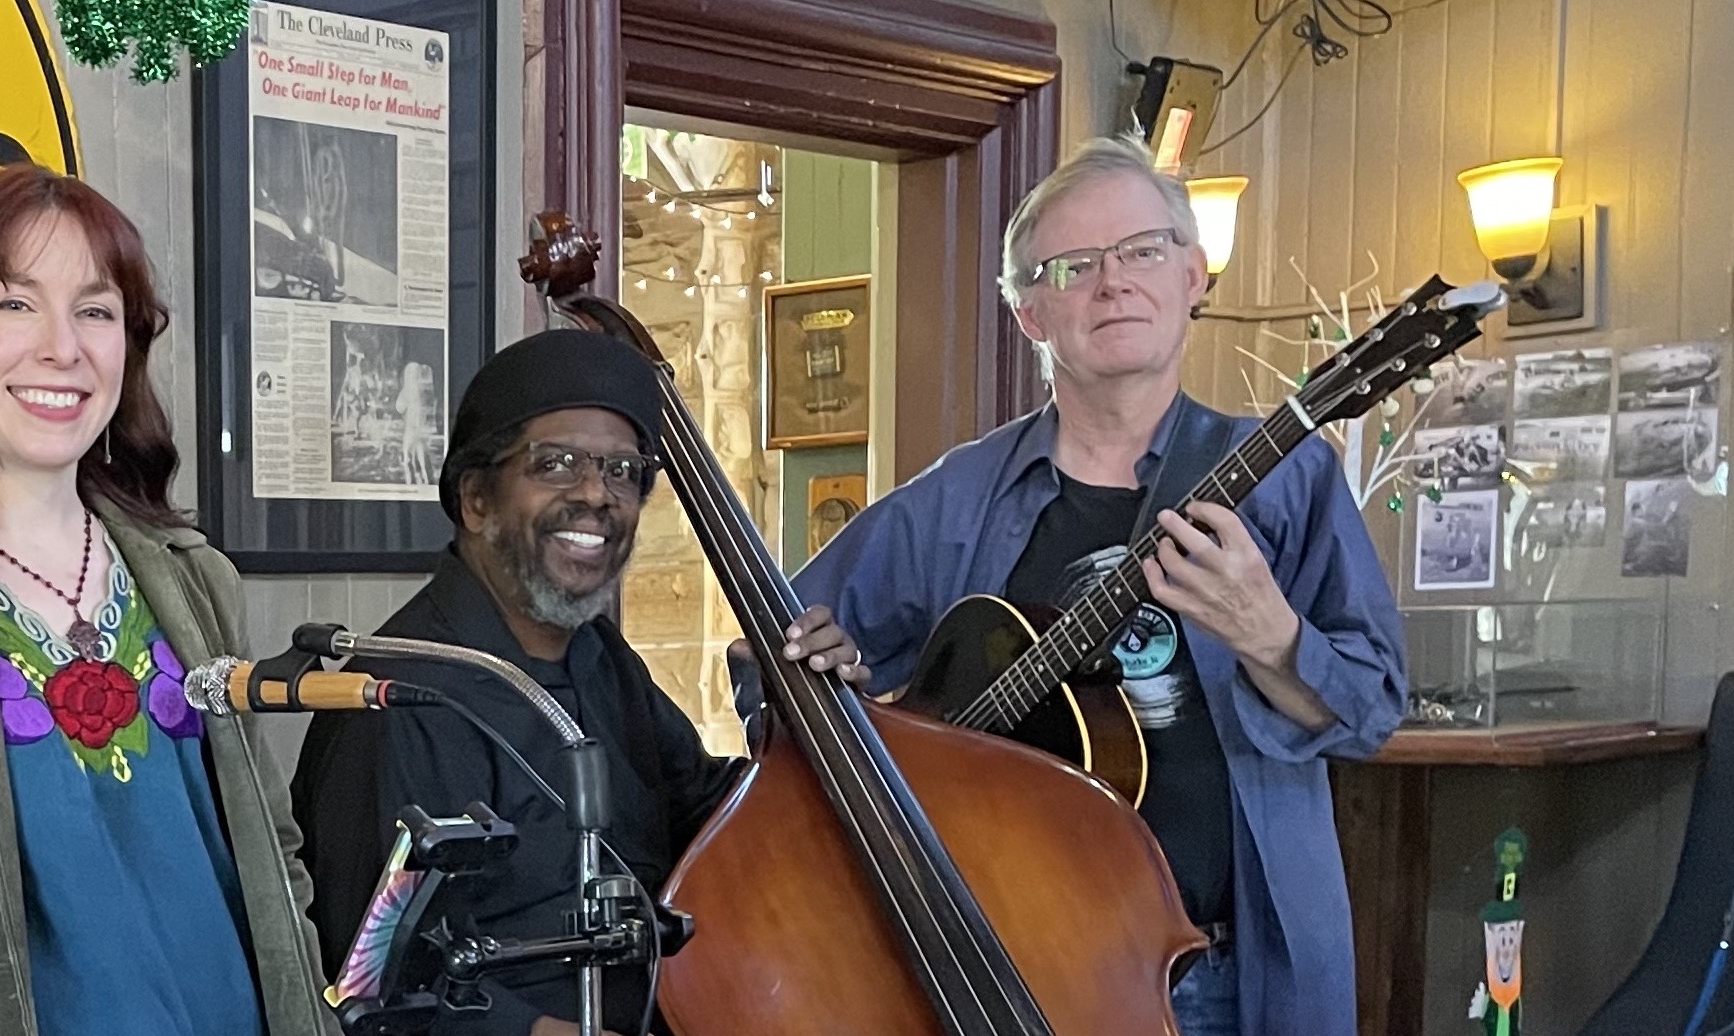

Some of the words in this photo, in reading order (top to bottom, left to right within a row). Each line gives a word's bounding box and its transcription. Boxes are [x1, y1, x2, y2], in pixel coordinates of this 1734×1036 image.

[277, 10, 303, 32] The
[308, 15, 370, 44] Cleveland
[376, 27, 413, 53] Press
[287, 56, 324, 78] Small
[327, 63, 355, 86] Step
[358, 68, 377, 86] for
[262, 77, 288, 97] One
[291, 83, 327, 102] Giant
[331, 90, 361, 111] Leap
[363, 94, 383, 111] for
